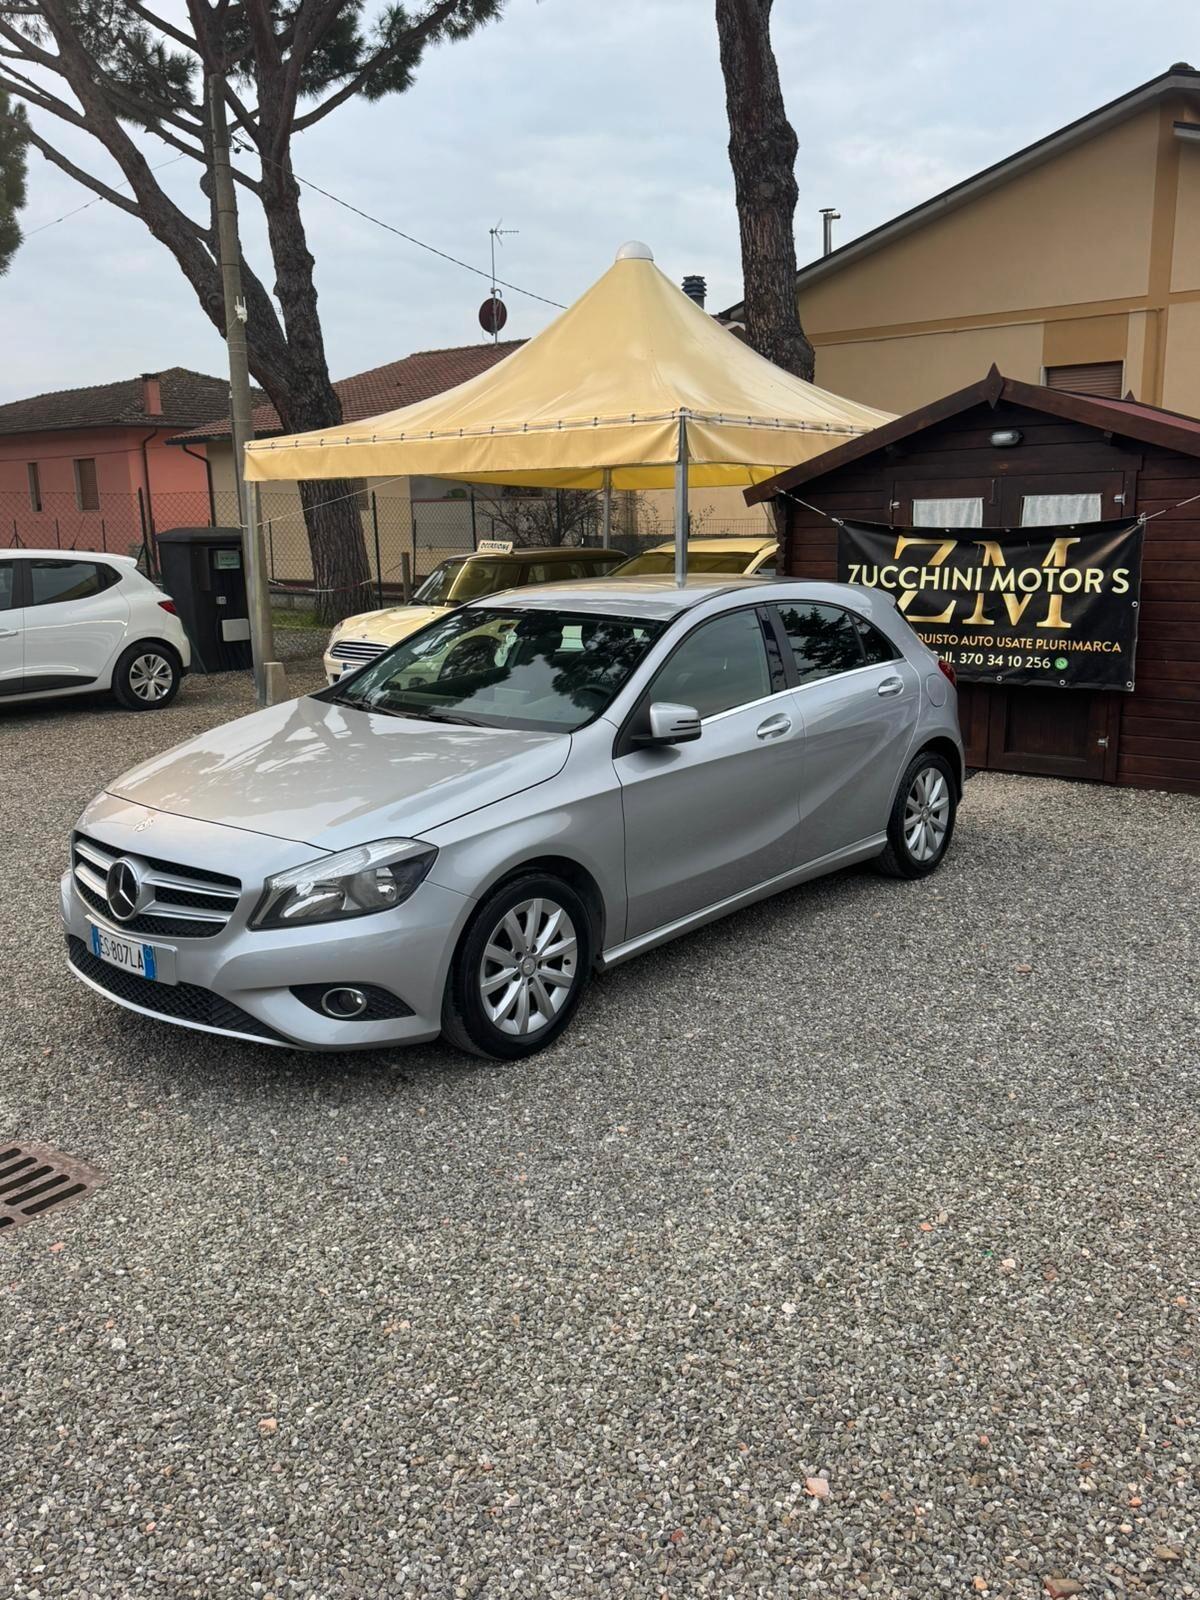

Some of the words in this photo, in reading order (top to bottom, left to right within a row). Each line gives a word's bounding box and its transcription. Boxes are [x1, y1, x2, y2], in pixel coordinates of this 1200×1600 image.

[848, 564, 982, 591] ZUCCHINI
[989, 567, 1130, 594] MOTORS
[893, 535, 1081, 628] ZM
[960, 635, 994, 647] AUTO
[996, 636, 1033, 649] USATE
[1035, 638, 1122, 653] PLURIMARCA
[959, 652, 984, 665] 370
[987, 654, 1004, 666] 34
[1007, 655, 1022, 667] 10
[1025, 656, 1051, 669] 256
